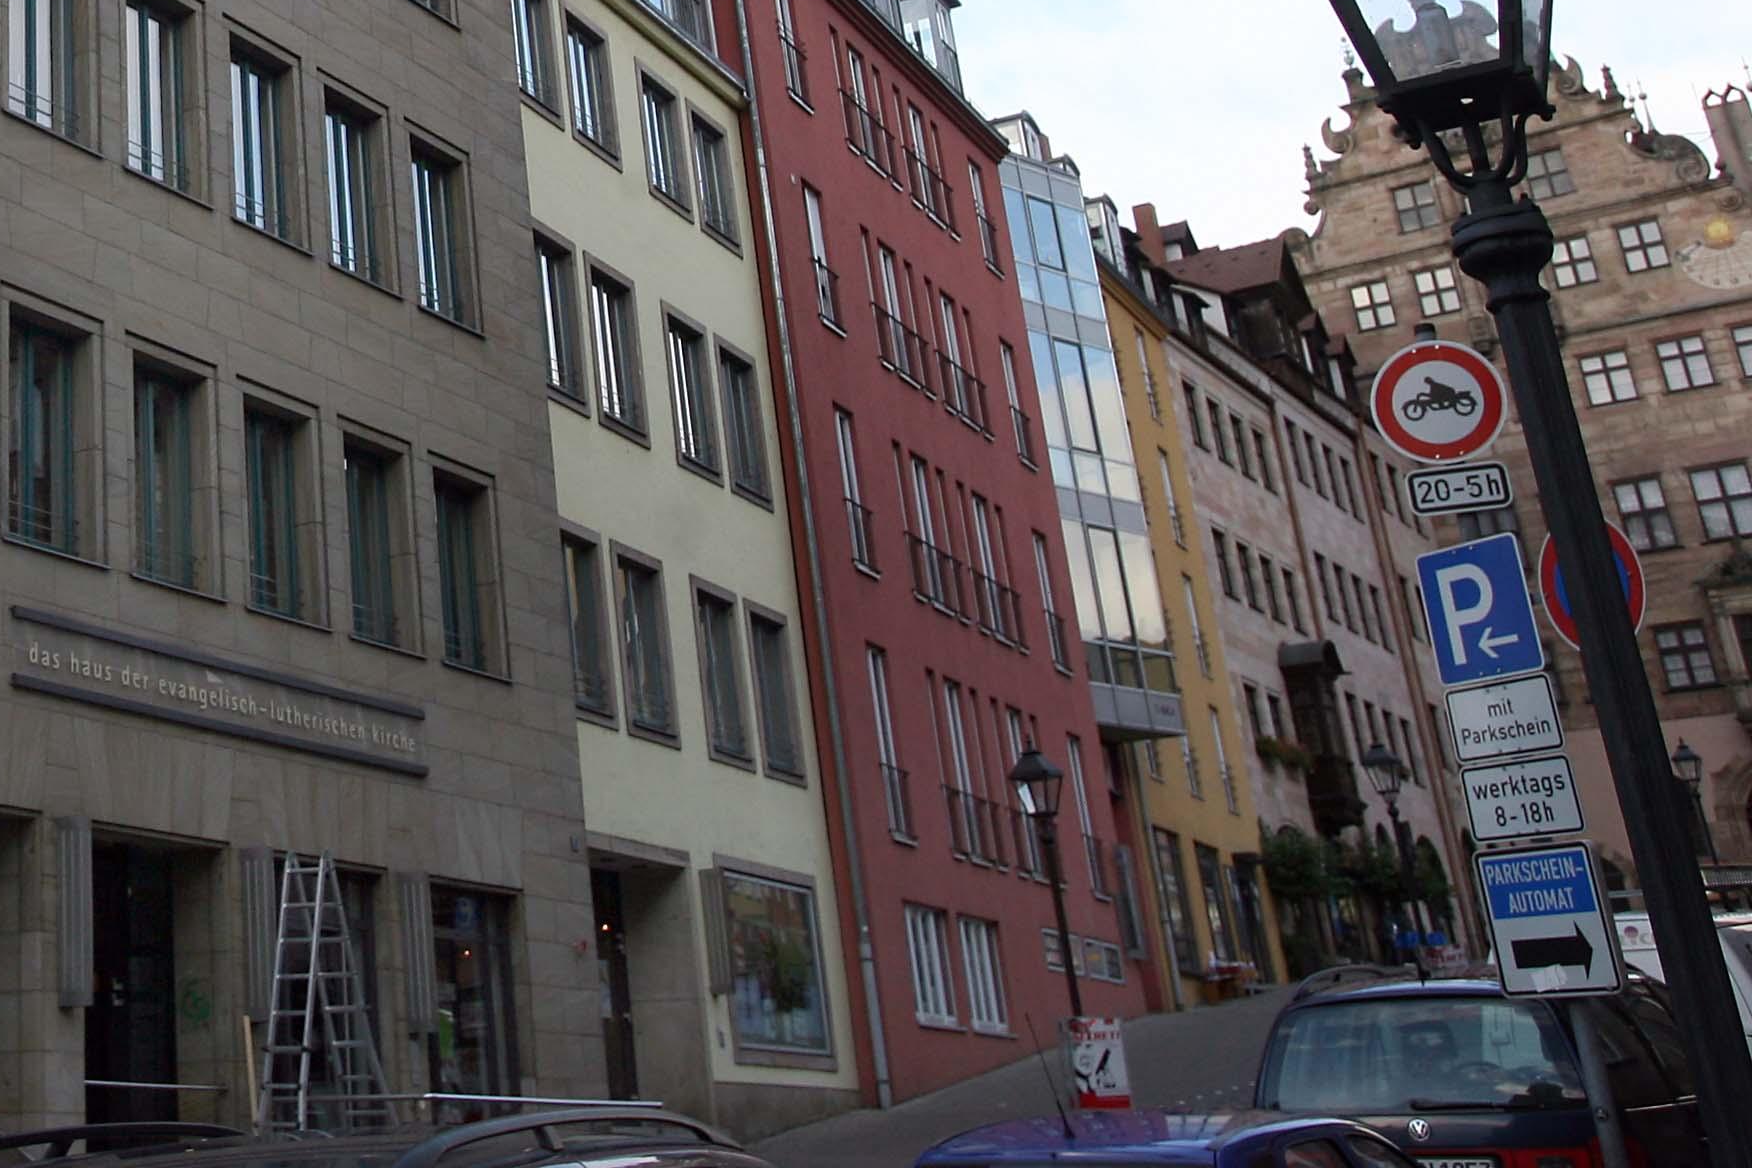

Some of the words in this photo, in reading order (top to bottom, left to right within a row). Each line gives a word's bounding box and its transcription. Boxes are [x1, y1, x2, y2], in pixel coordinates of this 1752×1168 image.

[1435, 563, 1494, 666] P
[28, 641, 61, 669] das
[70, 651, 113, 683] haus
[121, 664, 150, 690] der
[158, 677, 366, 741] evangelisch-lutherischen
[372, 721, 417, 754] kirche
[1487, 696, 1514, 718] mit
[1461, 714, 1551, 746] Parkschein
[1473, 773, 1566, 800] werktags
[1485, 855, 1585, 886] PARKSCHEIN-
[1508, 887, 1575, 915] AUTOMAT
